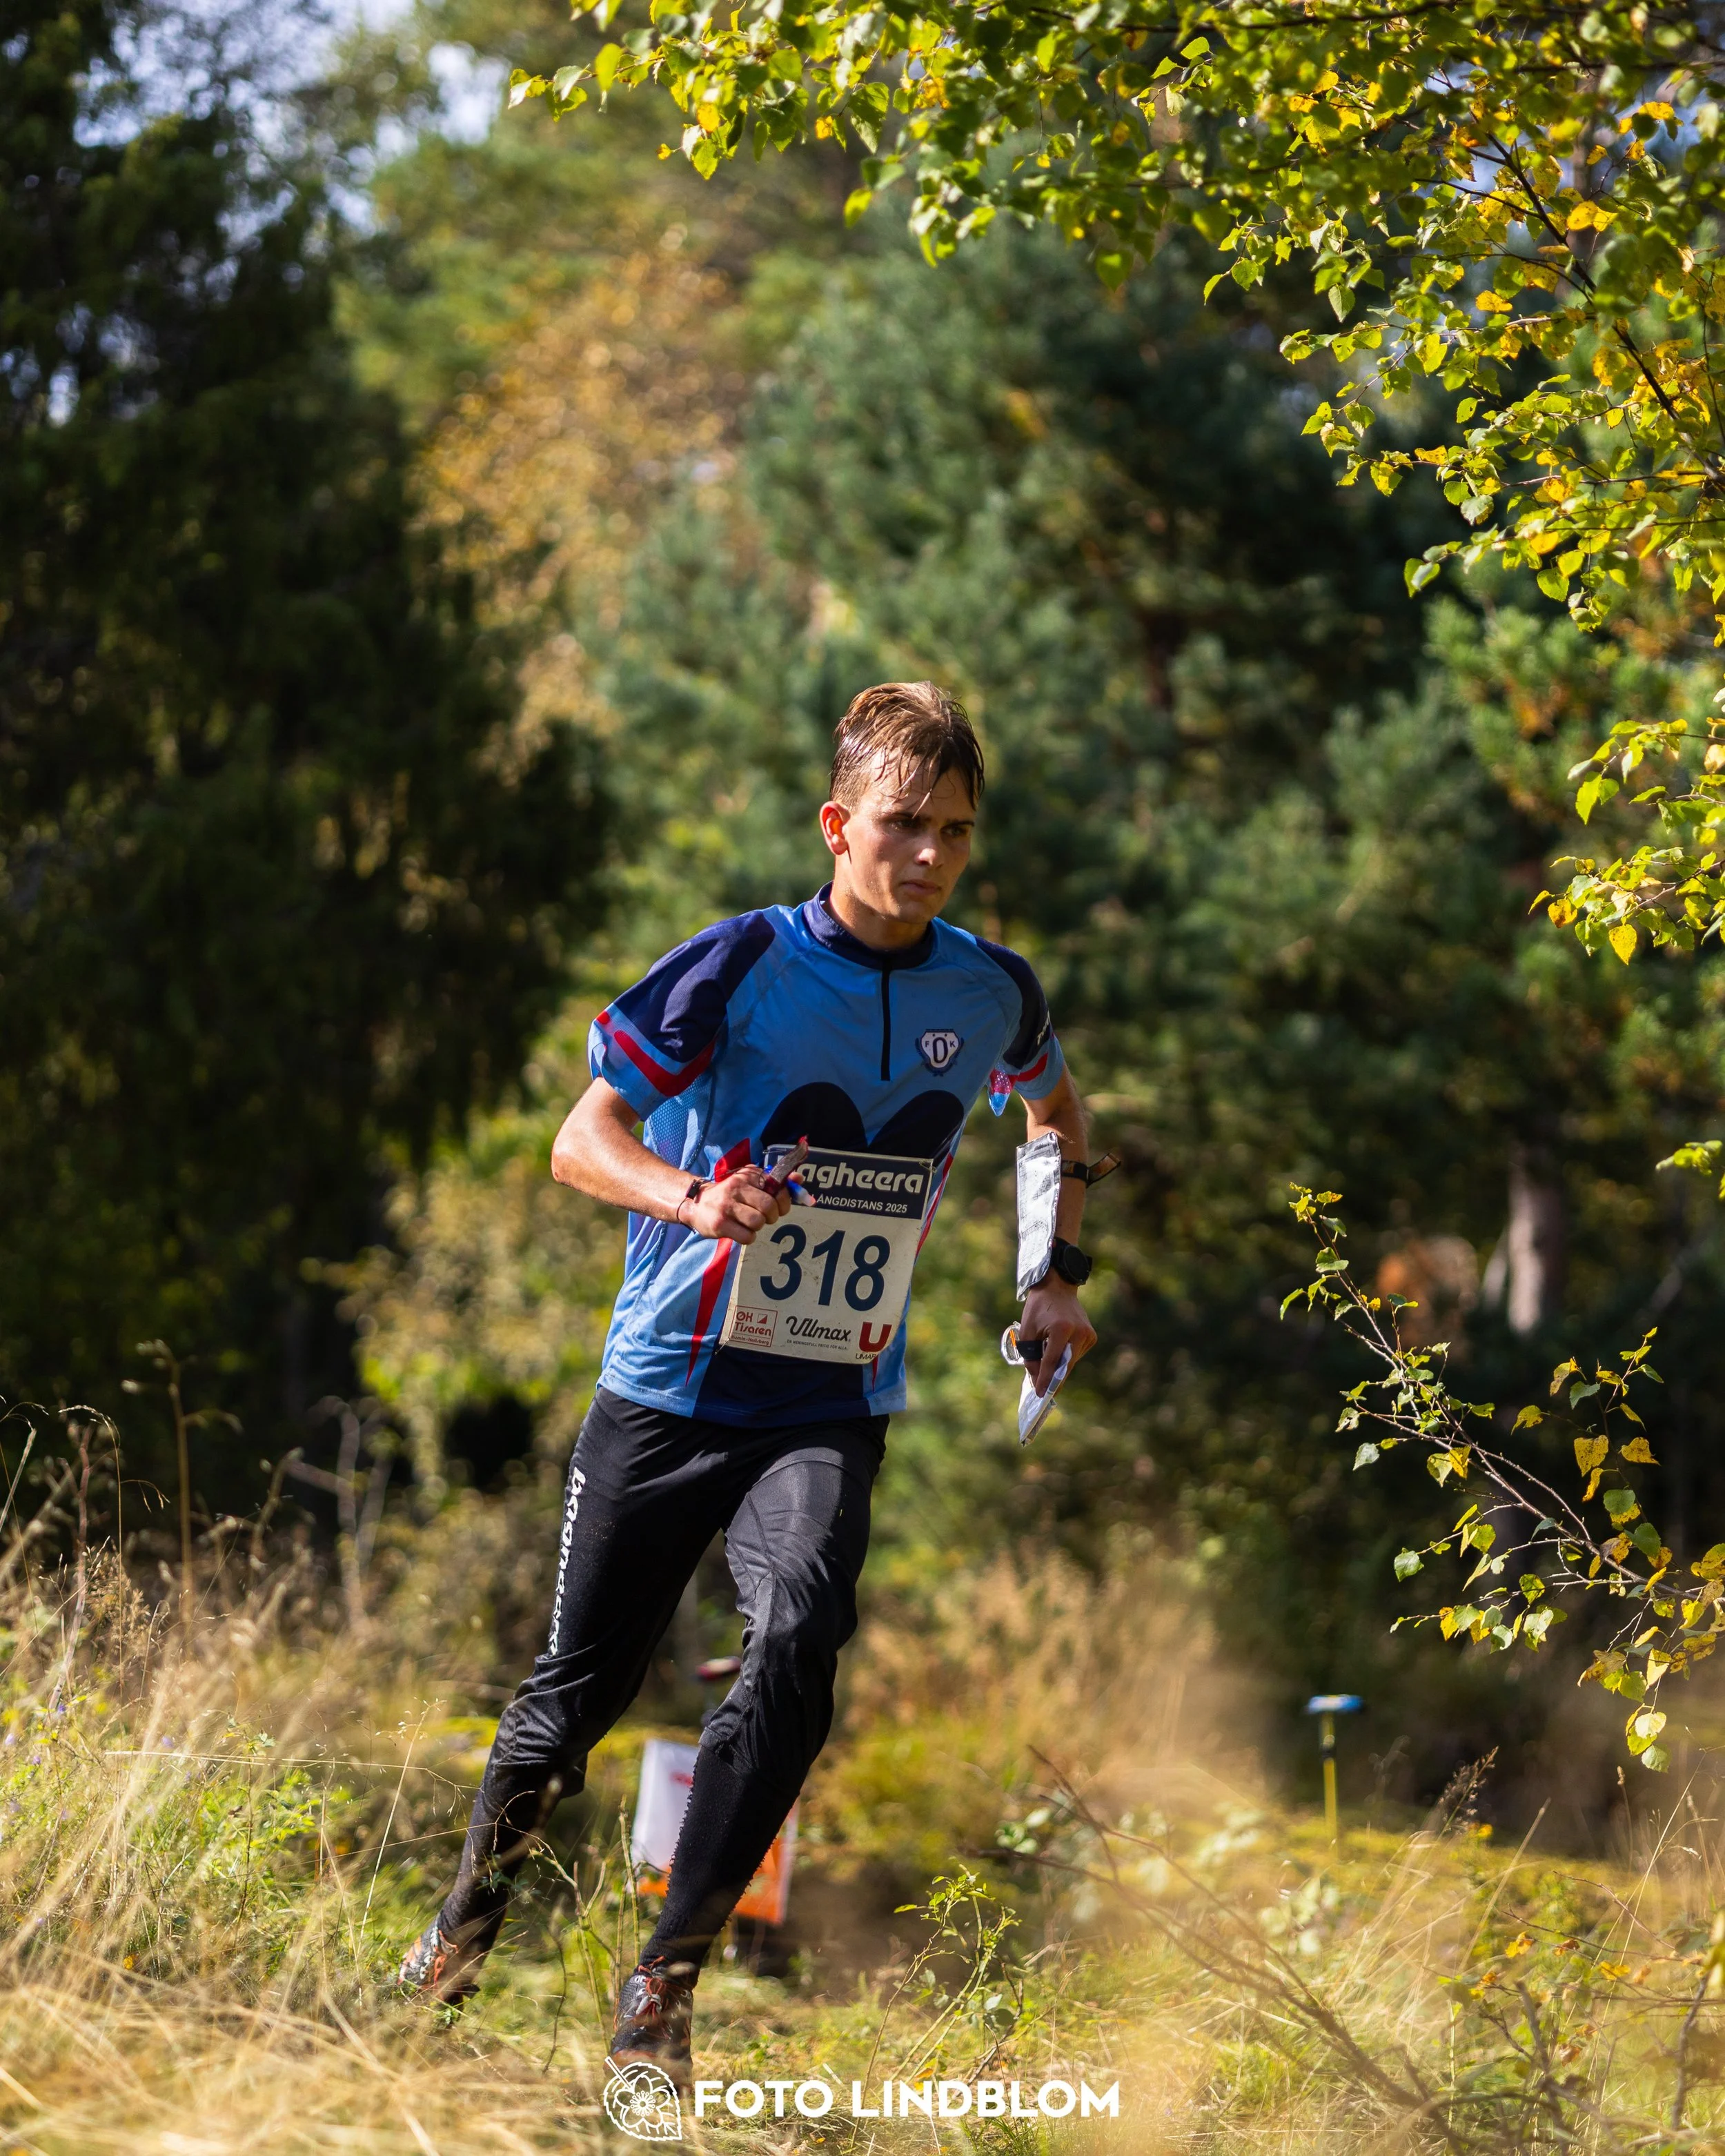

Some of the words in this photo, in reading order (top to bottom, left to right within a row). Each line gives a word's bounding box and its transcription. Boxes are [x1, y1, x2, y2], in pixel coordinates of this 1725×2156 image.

[778, 1155, 924, 1194] agheera
[812, 1194, 883, 1211] ÅNGDISTANS
[885, 1203, 907, 1213] 2025
[760, 1223, 890, 1312] 318
[735, 1321, 771, 1336] Tisaren
[786, 1316, 851, 1342] Ullmax
